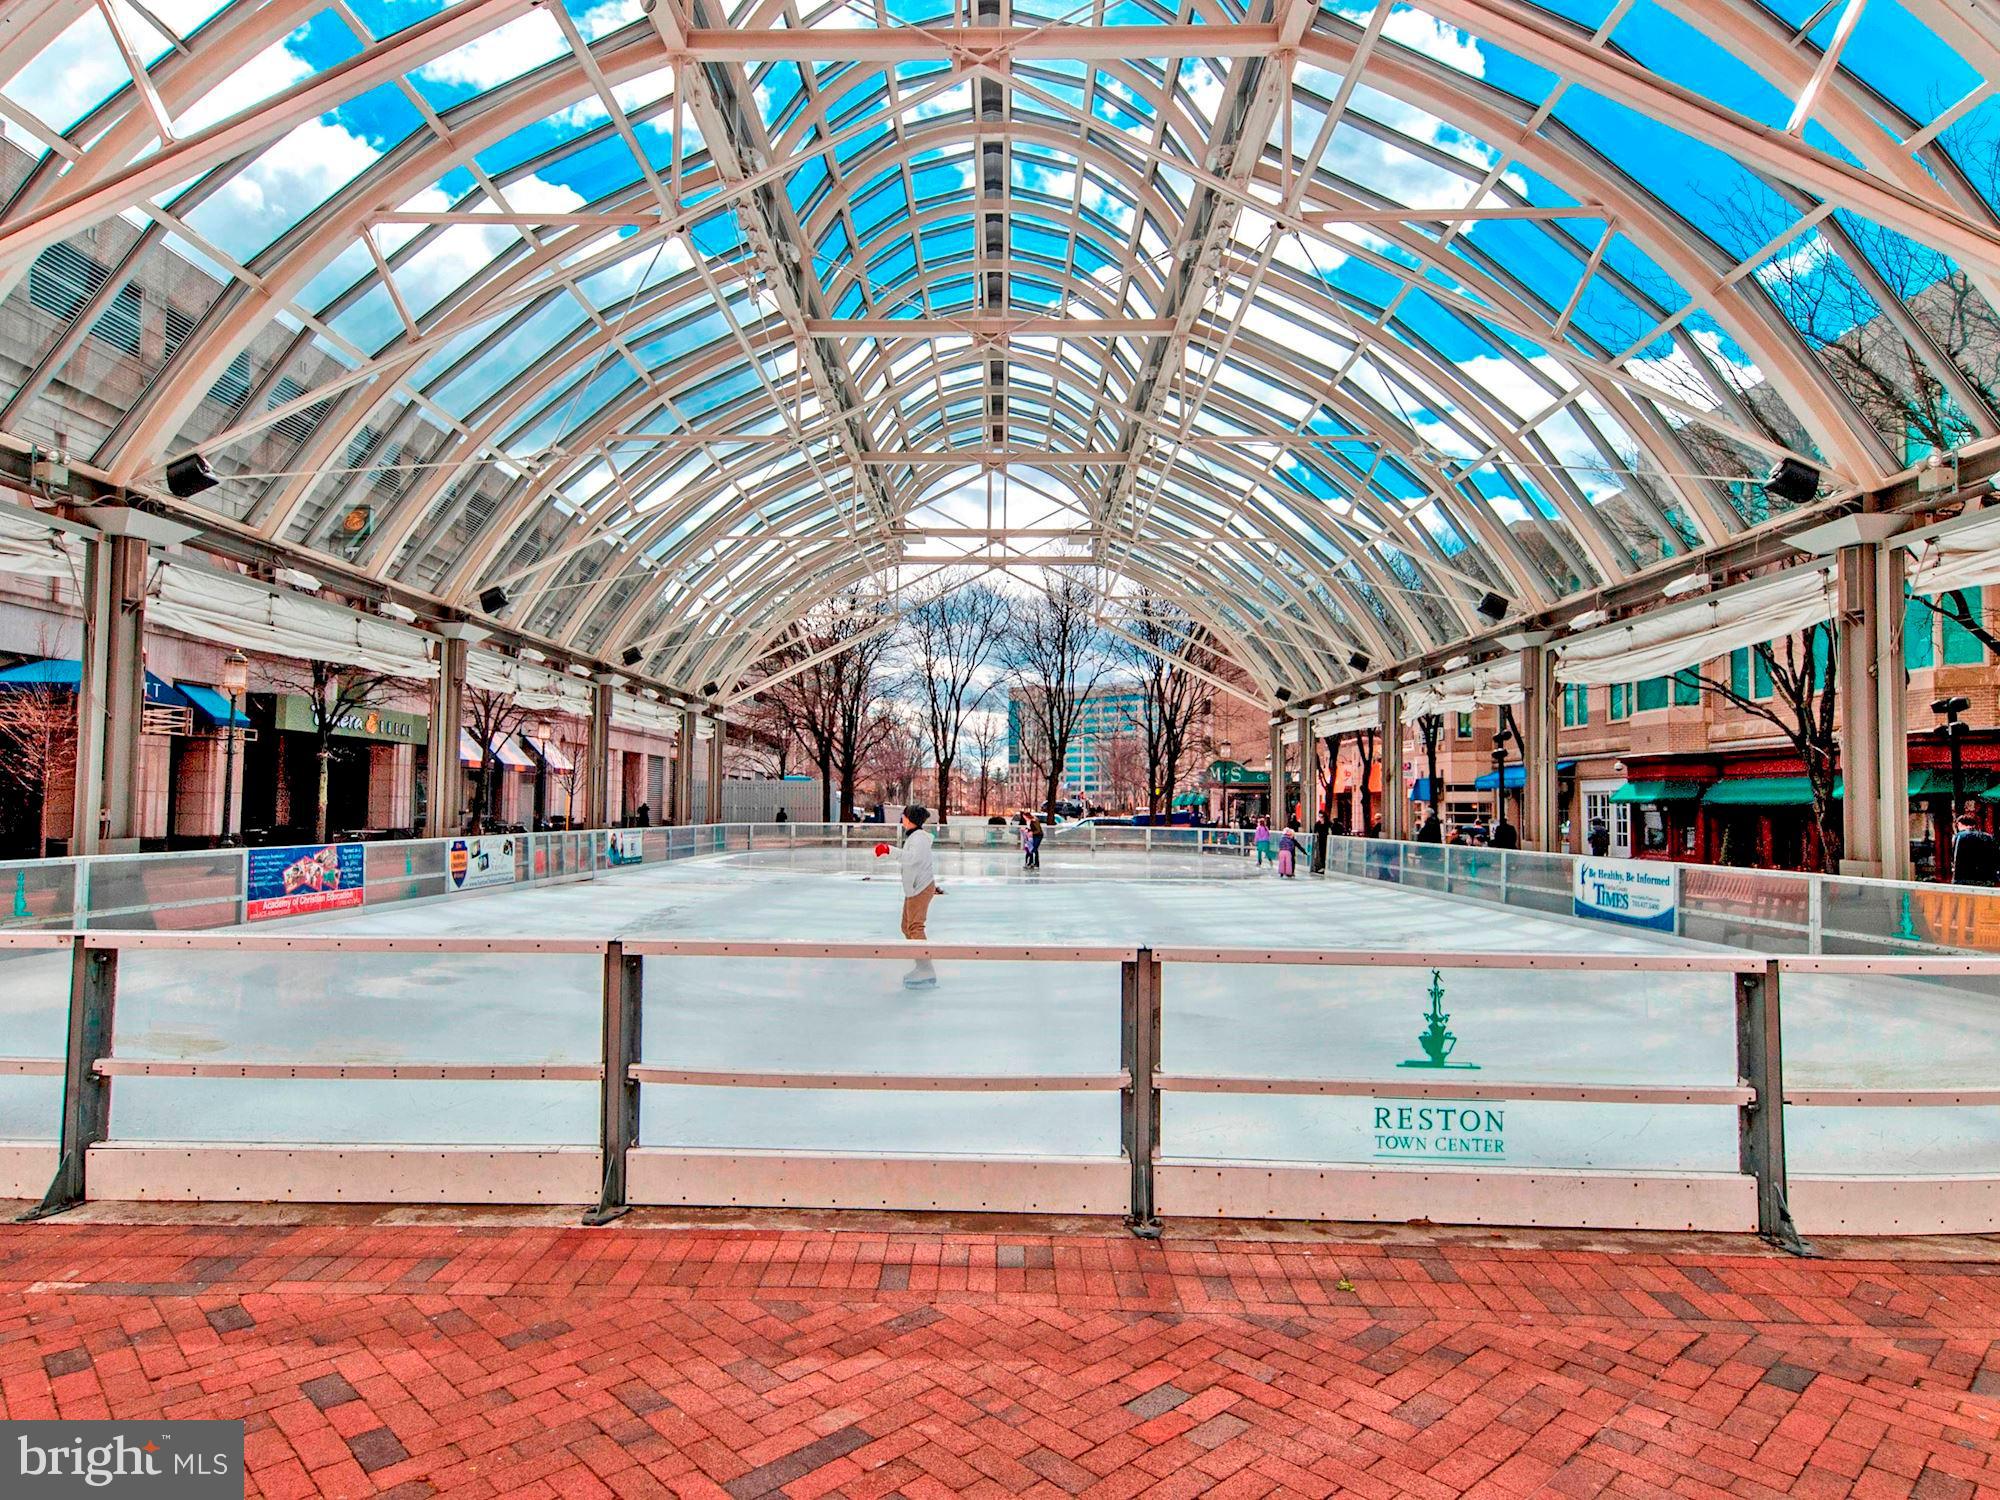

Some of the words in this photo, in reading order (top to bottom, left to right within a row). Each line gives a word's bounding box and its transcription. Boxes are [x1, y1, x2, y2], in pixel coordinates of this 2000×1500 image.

[1636, 873, 1670, 886] Informed
[262, 899, 291, 911] Academy
[300, 894, 326, 905] Christian
[327, 891, 354, 900] Education
[1593, 883, 1629, 910] TIMES
[1374, 1107, 1505, 1132] RESTON
[1375, 1135, 1426, 1151] TOWN
[1435, 1137, 1505, 1153] CENTER
